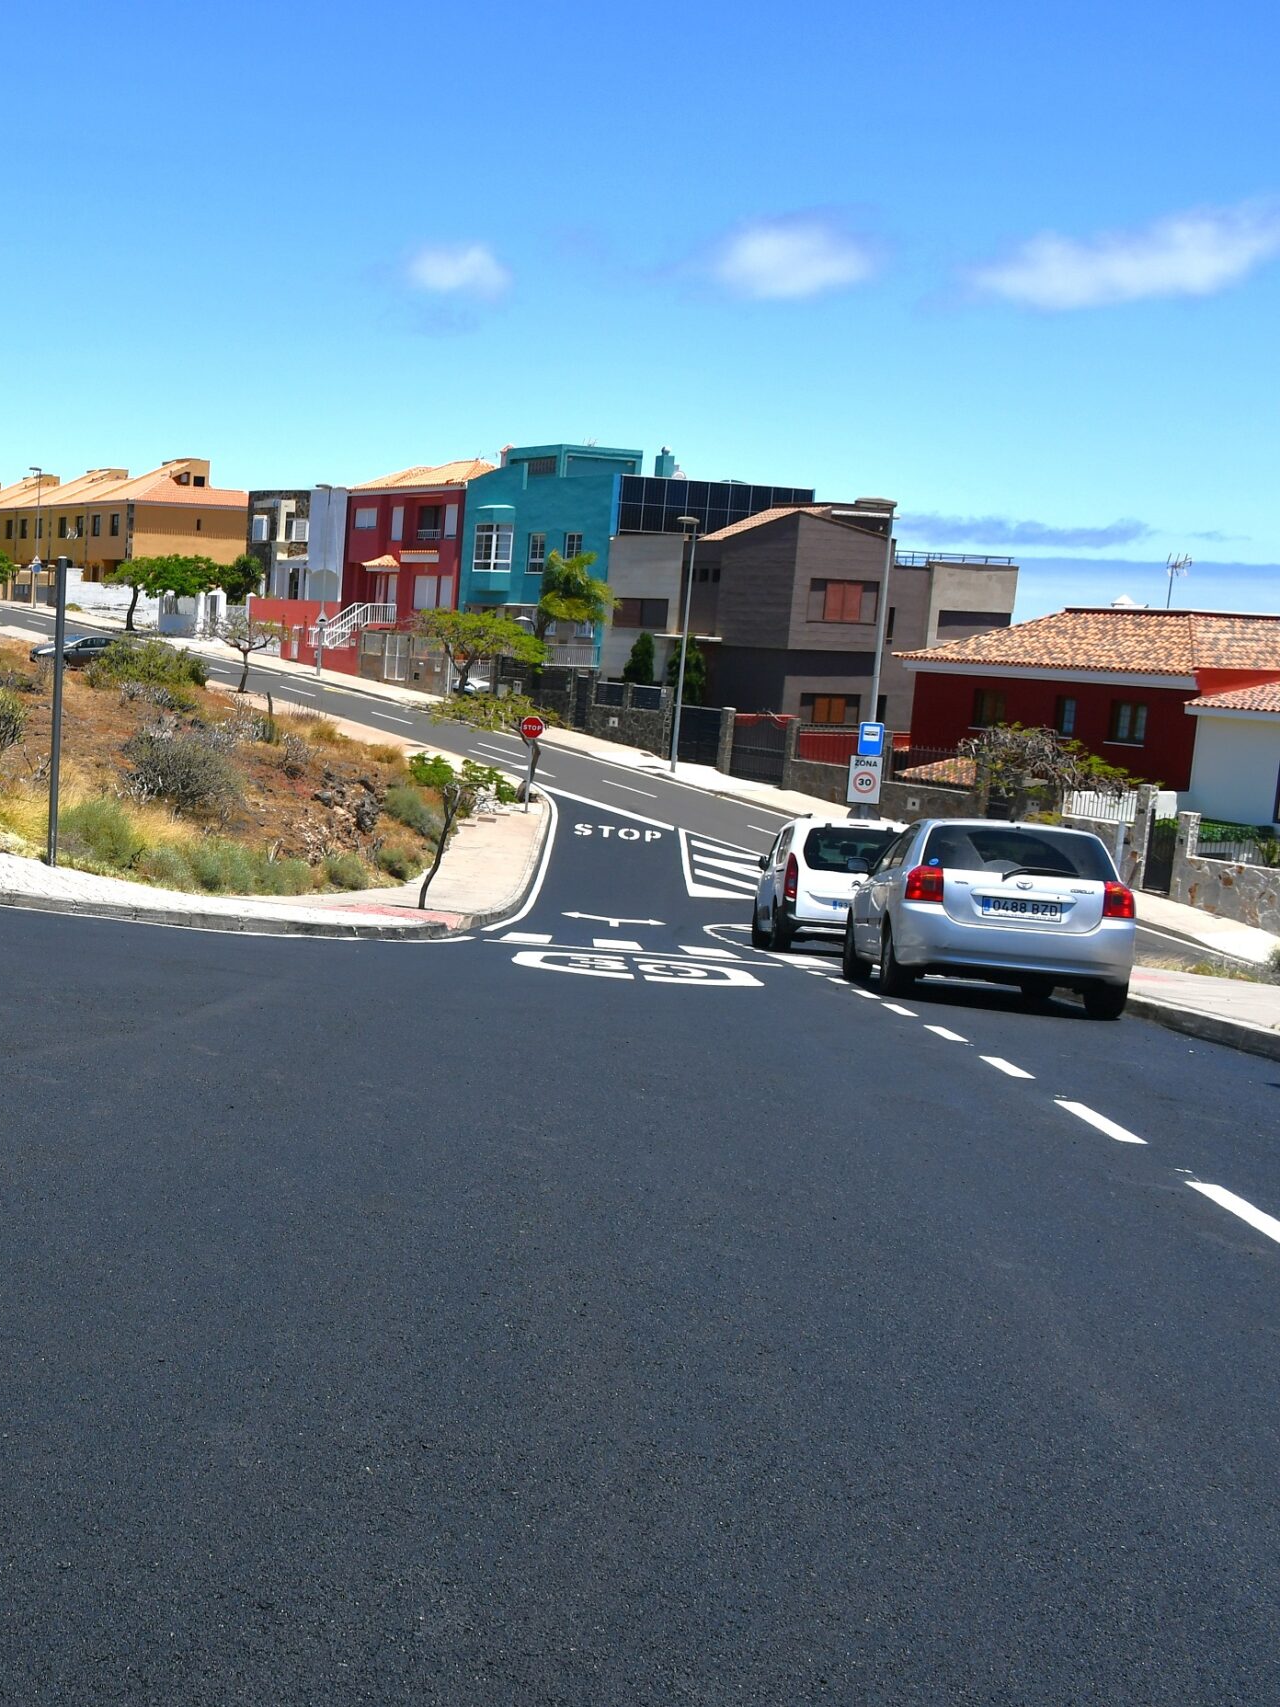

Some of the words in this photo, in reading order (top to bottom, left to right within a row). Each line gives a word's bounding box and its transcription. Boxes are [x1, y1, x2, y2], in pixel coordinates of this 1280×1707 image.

[854, 759, 878, 768] ZONA
[858, 778, 872, 786] 30
[574, 823, 662, 842] STOP
[992, 899, 1027, 914] 0488
[1031, 903, 1058, 917] BZD
[568, 956, 708, 978] 30
